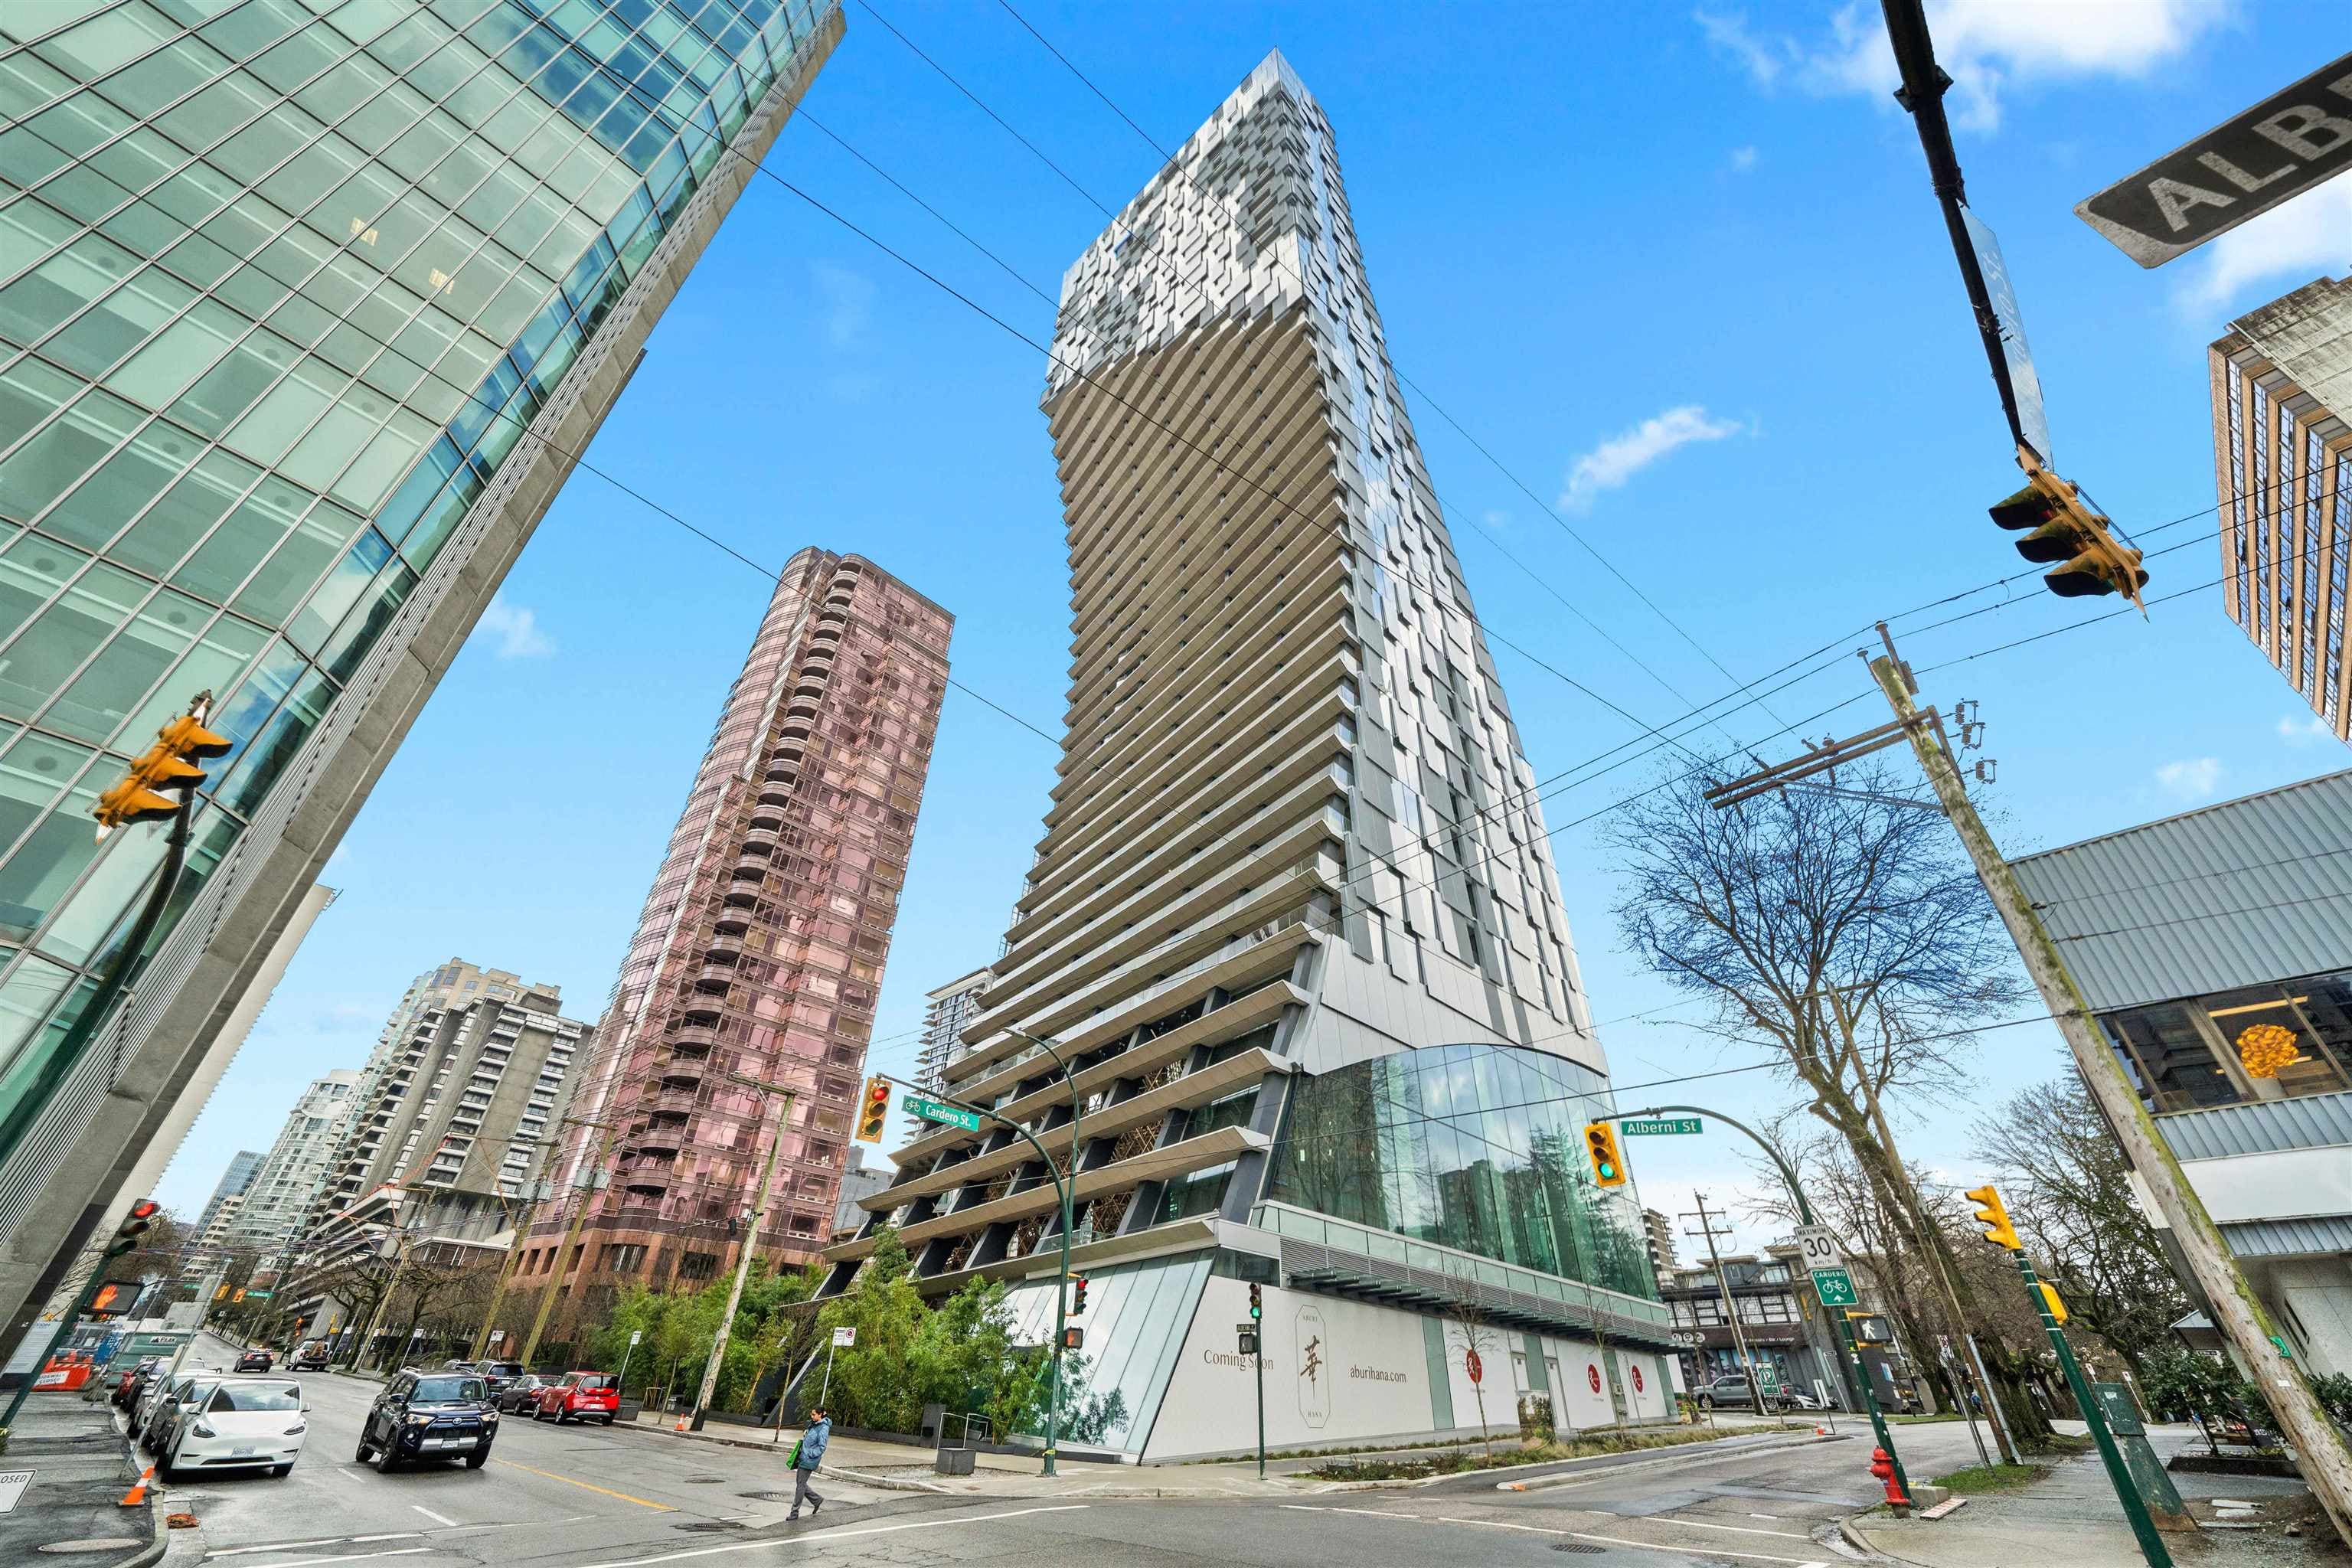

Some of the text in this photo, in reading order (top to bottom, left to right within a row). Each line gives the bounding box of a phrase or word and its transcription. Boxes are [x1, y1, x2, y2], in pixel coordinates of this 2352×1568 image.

[926, 1105, 972, 1128] Cardero St.
[1627, 1120, 1697, 1134] Alberni St
[1797, 1227, 1827, 1236] MAXIMUM
[1804, 1236, 1831, 1257] 30
[1204, 1349, 1246, 1371] Coming
[1350, 1364, 1407, 1383] aburihana.com
